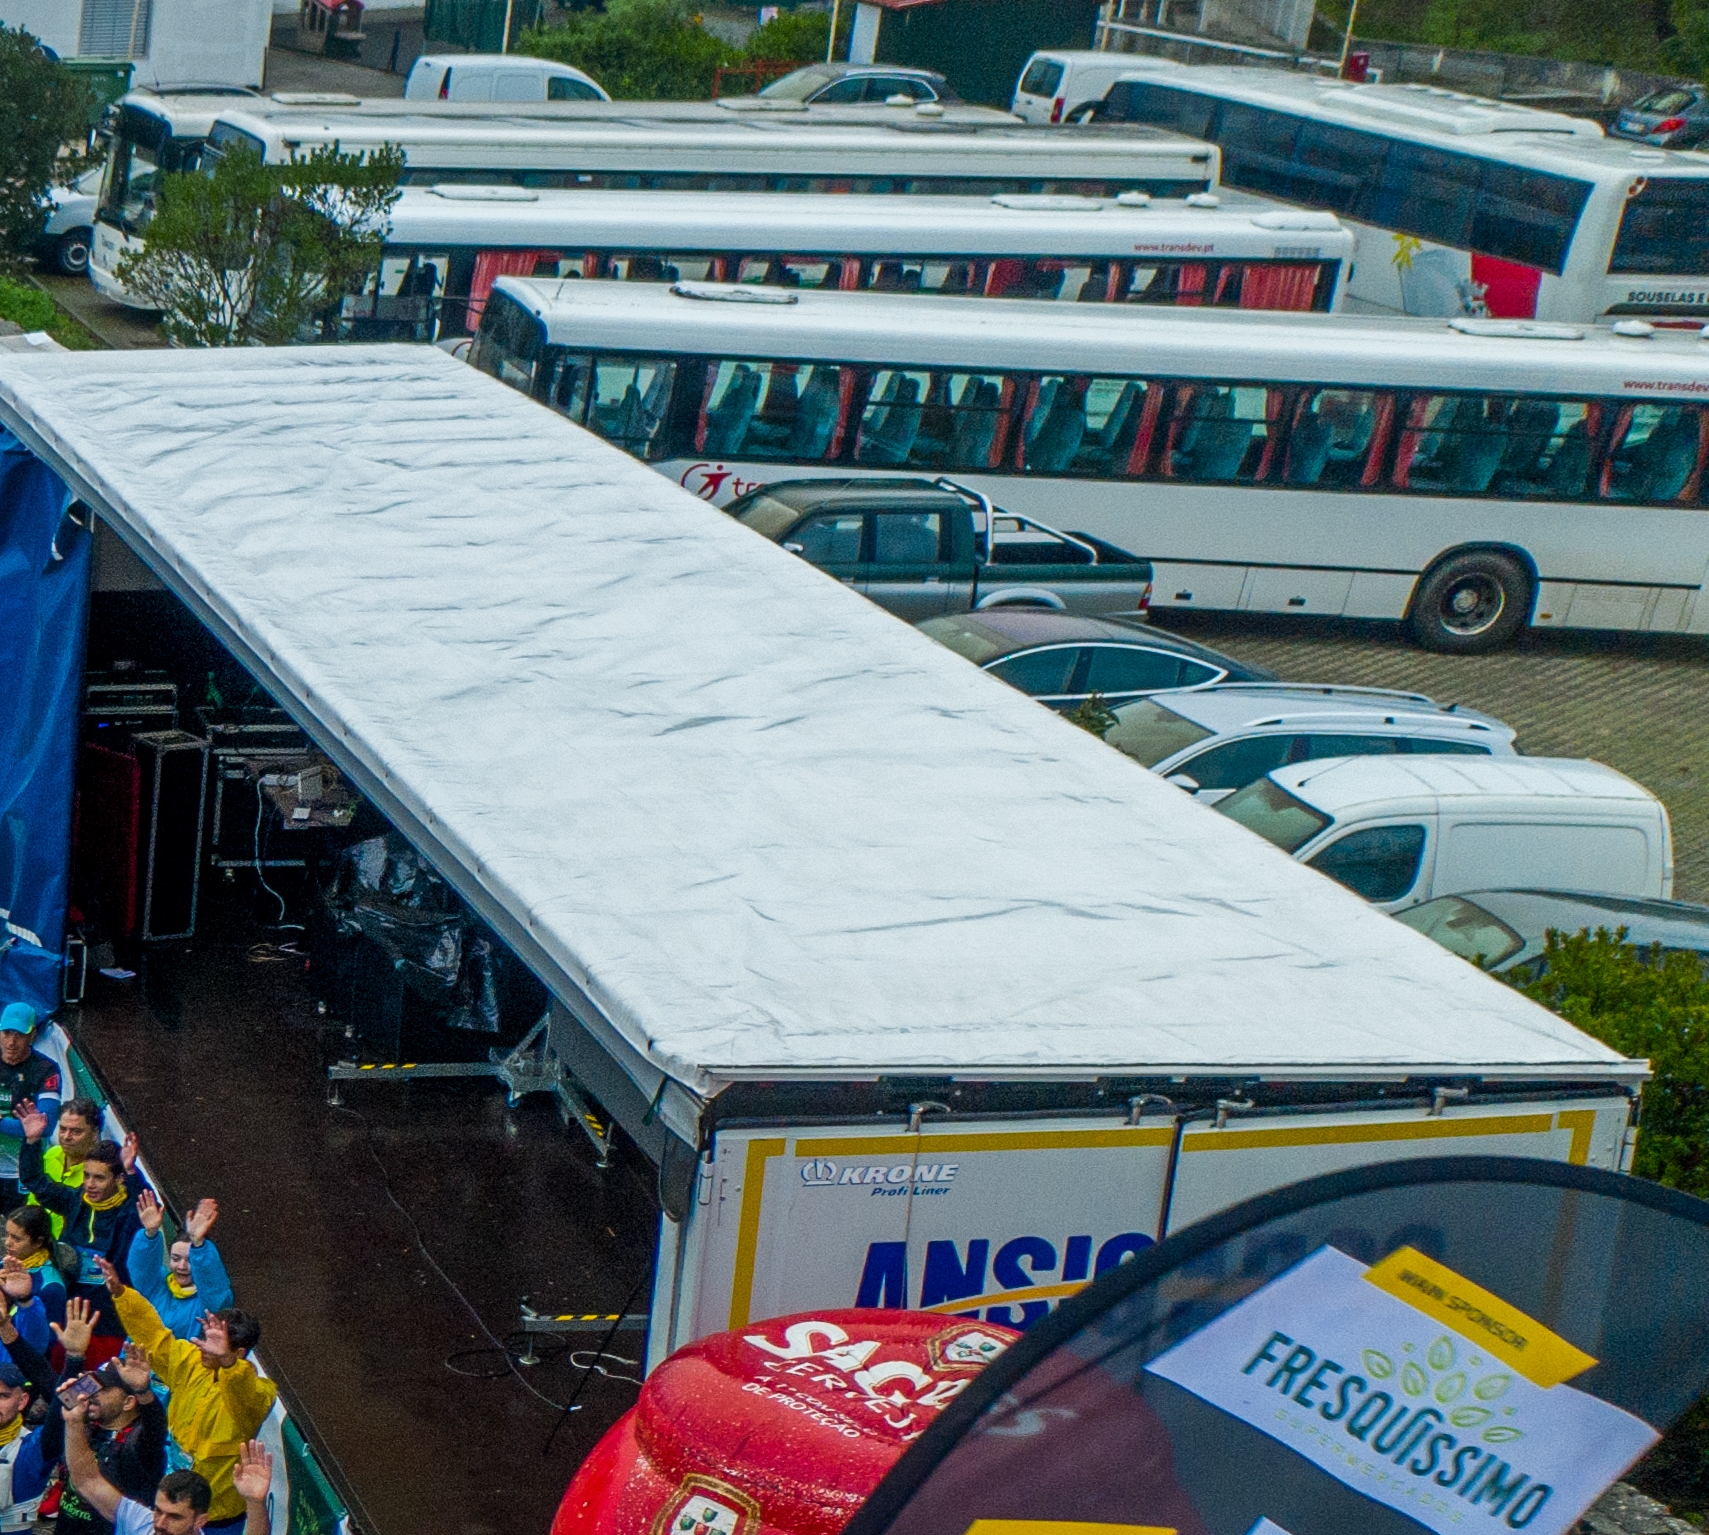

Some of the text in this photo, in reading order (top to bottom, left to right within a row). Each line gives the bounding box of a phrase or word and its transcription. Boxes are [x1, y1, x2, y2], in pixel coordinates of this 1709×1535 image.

[835, 1162, 959, 1187] KRONE
[1446, 1295, 1531, 1355] SPONSOR
[741, 1381, 861, 1438] DE PROTEÇÃO
